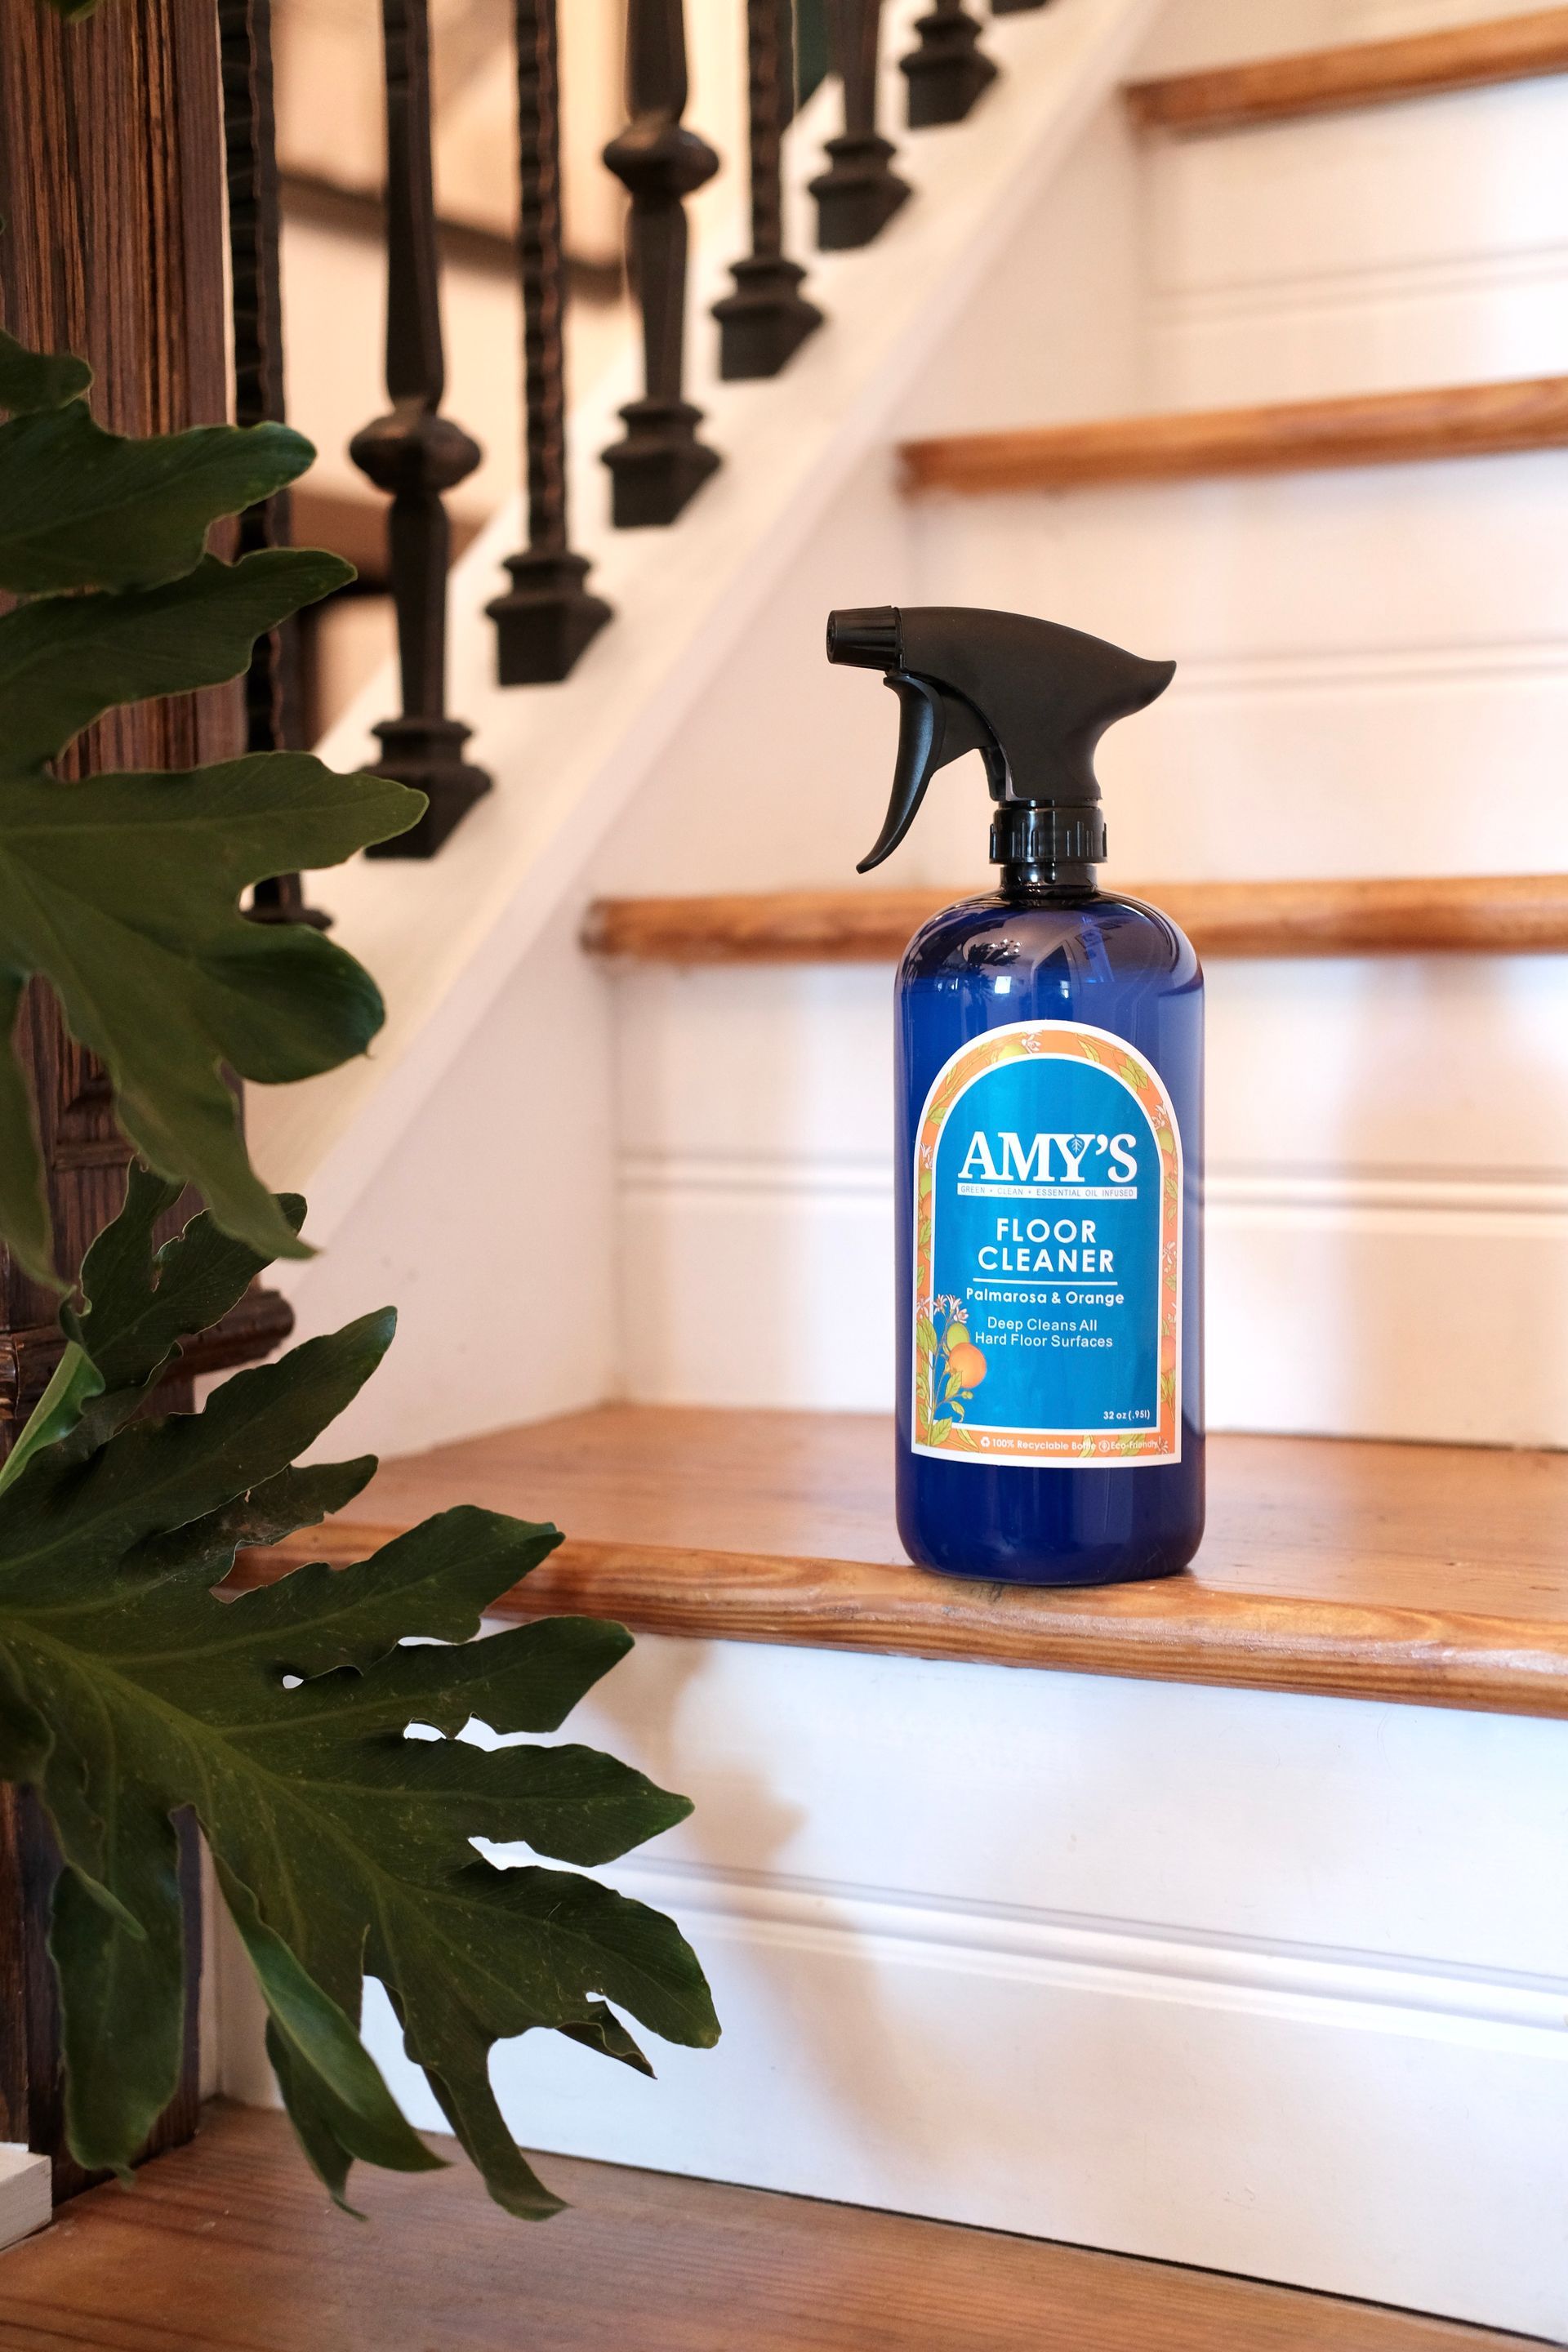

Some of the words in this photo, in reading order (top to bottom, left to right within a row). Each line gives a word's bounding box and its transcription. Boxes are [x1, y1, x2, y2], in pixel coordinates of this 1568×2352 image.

[957, 1130, 1138, 1183] AMY'S
[960, 1185, 985, 1194] GREEN
[997, 1187, 1023, 1196] CLEAN
[1036, 1188, 1080, 1196] ESSENTIAL
[996, 1218, 1096, 1244] FLOOR
[978, 1246, 1114, 1273] CLEANER
[966, 1287, 1047, 1304] Palmarosa
[1051, 1293, 1061, 1304] &
[1065, 1291, 1125, 1307] Orange
[987, 1316, 1022, 1331] Deep
[1027, 1318, 1076, 1331] Cleans
[1080, 1319, 1098, 1331] All
[975, 1331, 1007, 1345] Hard
[1010, 1333, 1049, 1347] Floor
[1050, 1334, 1113, 1348] Surfaces
[1103, 1410, 1114, 1420] 32
[992, 1438, 1014, 1448] 100%
[1017, 1440, 1069, 1450] Recyclable
[1071, 1441, 1097, 1450] Bottle
